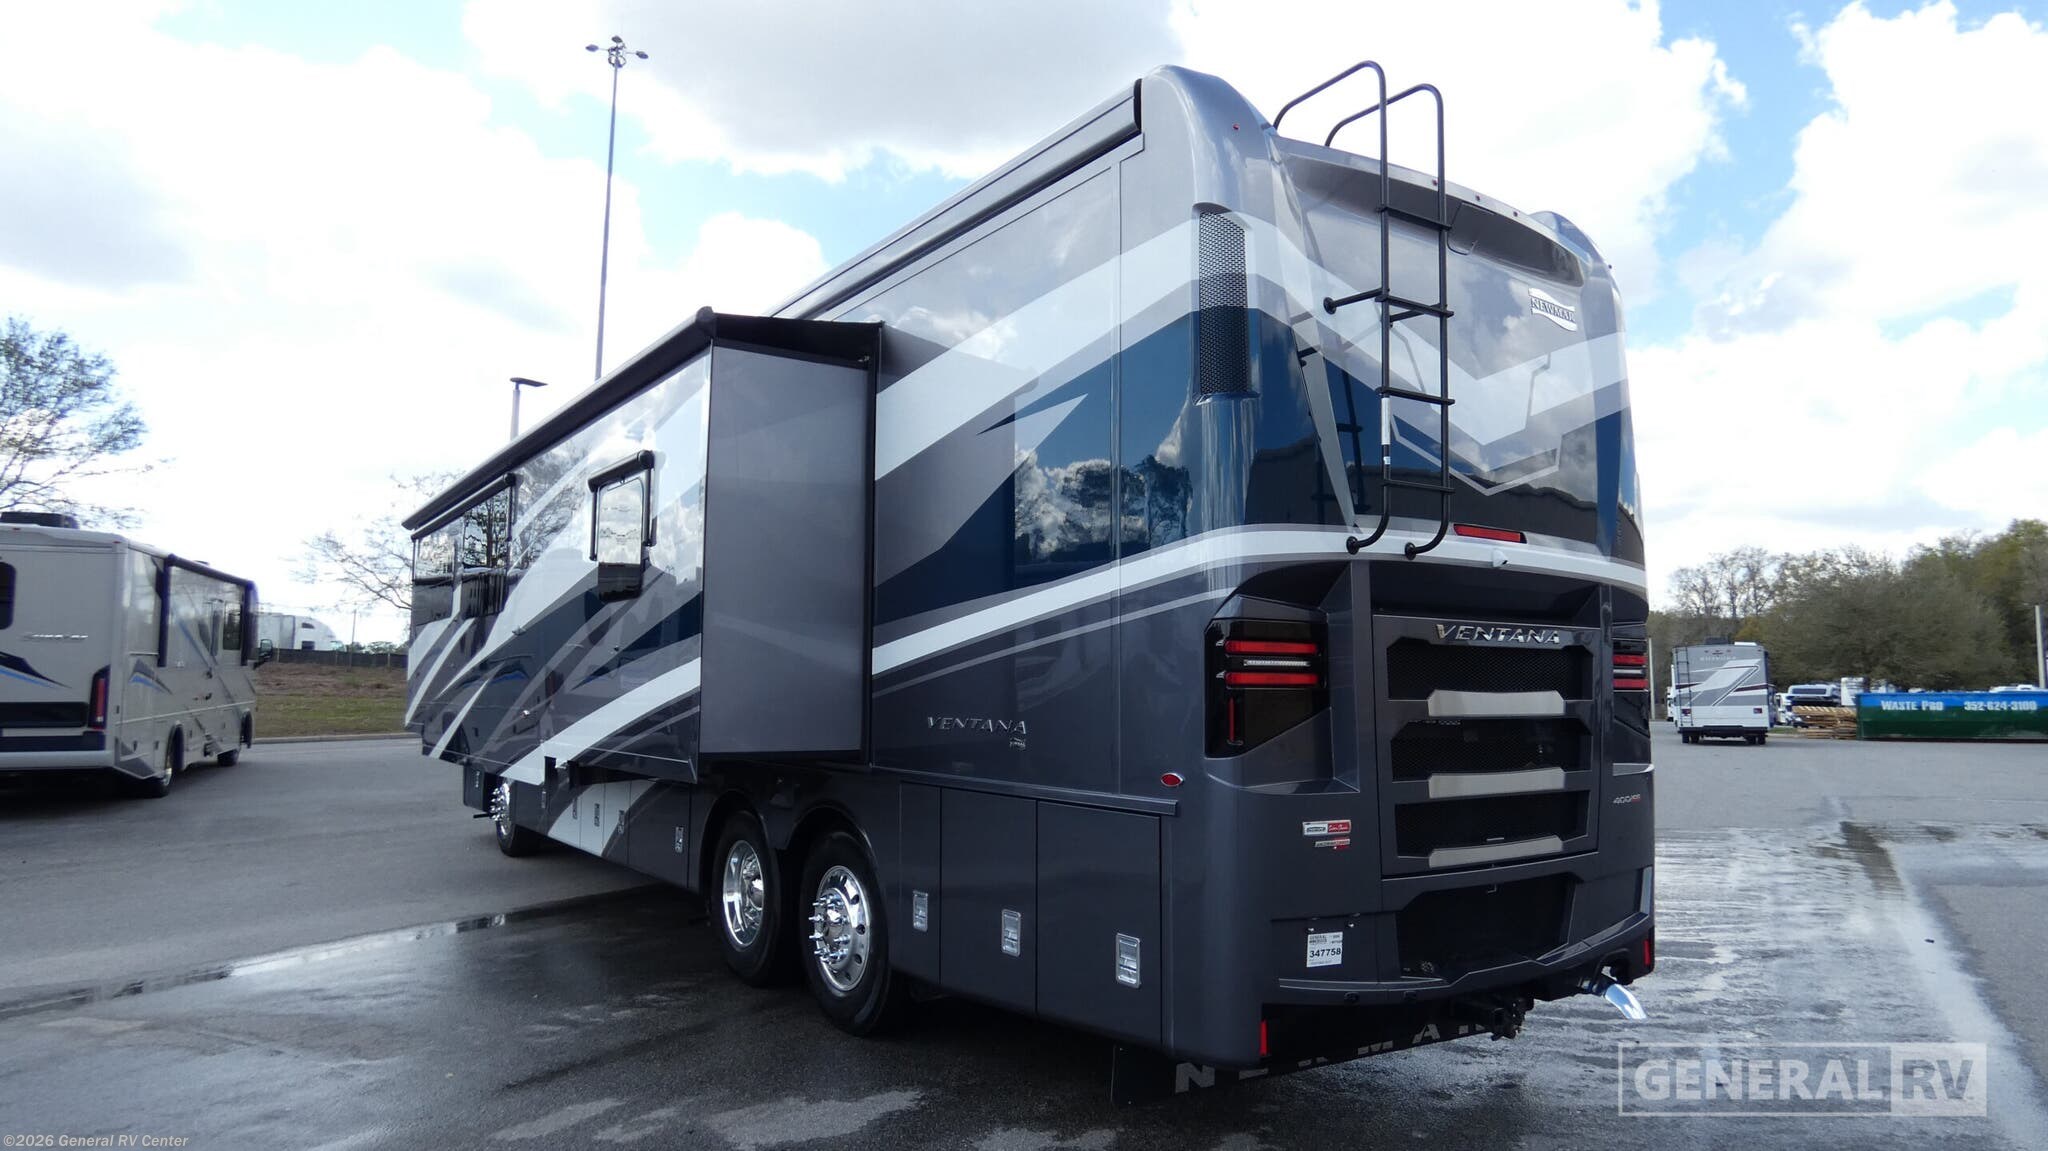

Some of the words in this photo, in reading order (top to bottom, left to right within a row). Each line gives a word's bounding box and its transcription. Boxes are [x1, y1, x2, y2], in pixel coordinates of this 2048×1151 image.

[1530, 297, 1576, 323] NEWMAR
[1436, 624, 1561, 644] VENTANA
[927, 716, 1026, 735] VENTANA
[1309, 947, 1342, 958] 347758
